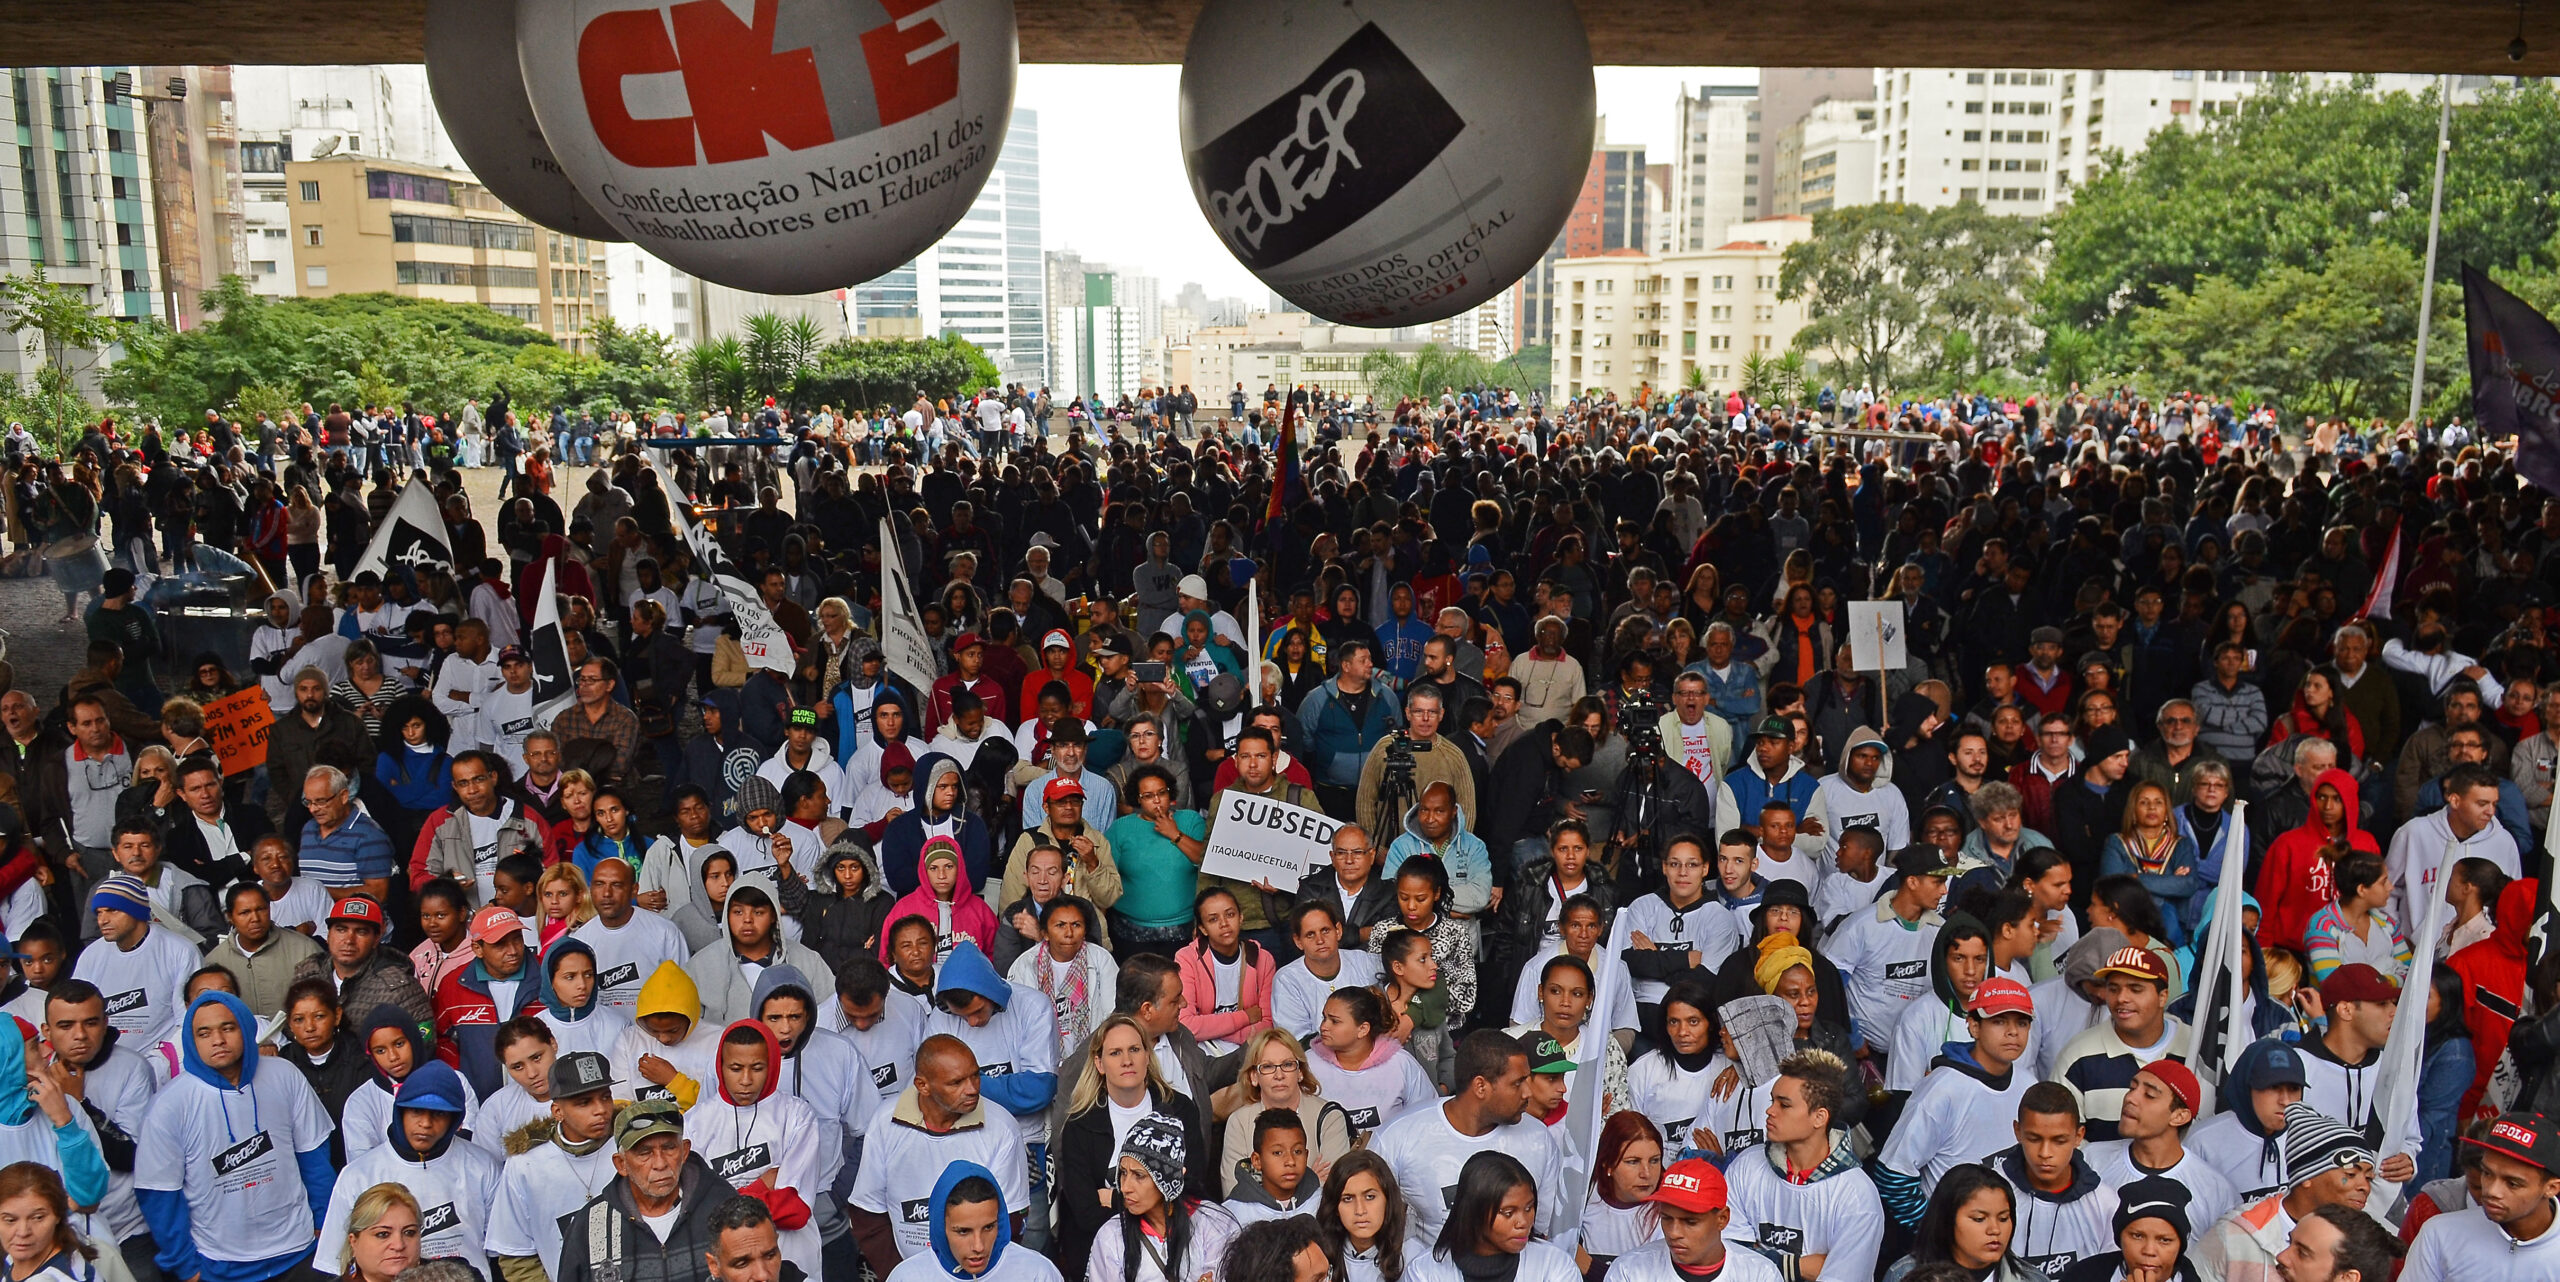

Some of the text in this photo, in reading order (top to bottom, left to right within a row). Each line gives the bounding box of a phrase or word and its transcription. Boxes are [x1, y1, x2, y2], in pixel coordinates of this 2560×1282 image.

[602, 114, 984, 214] Confederação Nacional dos
[619, 144, 986, 243] Trabalhadores em Educação
[1348, 264, 1424, 299] ENSINO
[1427, 209, 1515, 267] OFICIAL
[1361, 253, 1408, 280] DOS
[1413, 249, 1481, 292] PAULO
[1384, 637, 1422, 662] GAP
[240, 712, 263, 729] DAS
[1056, 778, 1076, 787] CUT
[1229, 798, 1335, 845] SUBSED
[1211, 845, 1298, 873] ITAQUAQUECETUBA
[105, 990, 142, 1013] APEOESP
[221, 1135, 264, 1170] APEOESP
